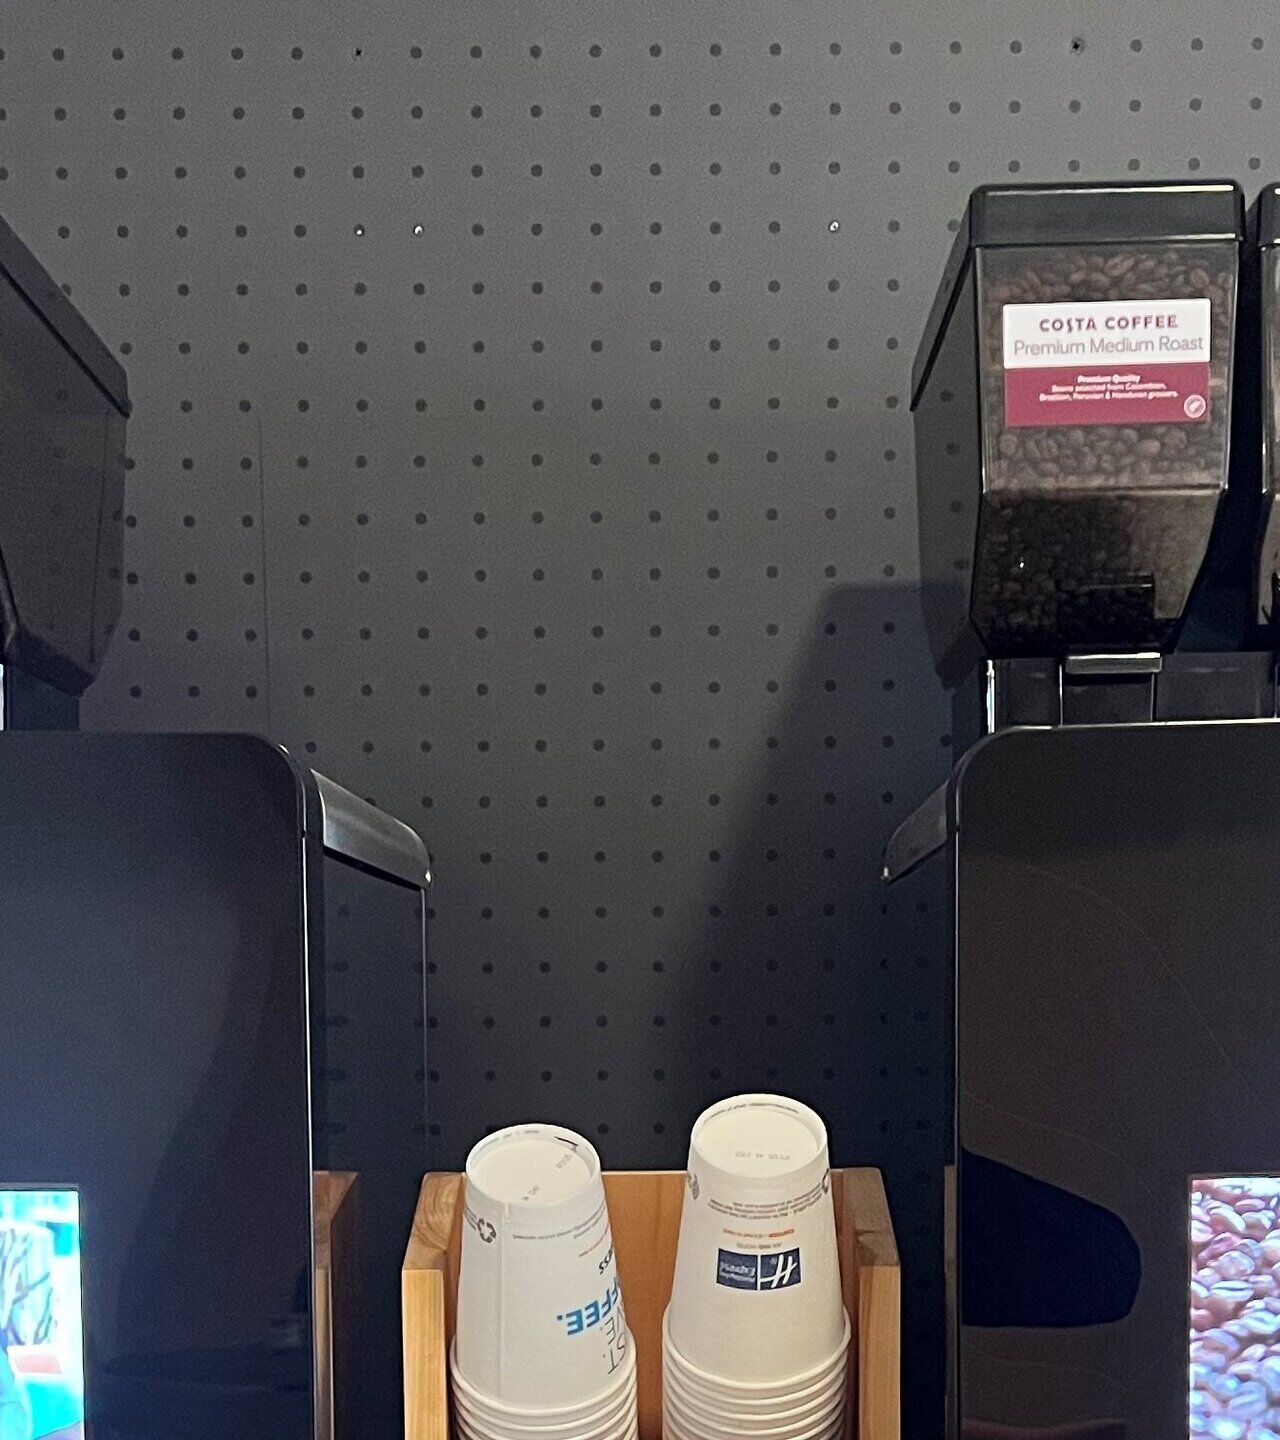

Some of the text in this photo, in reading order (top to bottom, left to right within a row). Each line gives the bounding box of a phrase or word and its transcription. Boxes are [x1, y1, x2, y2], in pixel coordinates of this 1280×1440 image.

[1039, 315, 1179, 334] COSTA COFFEE
[1014, 335, 1204, 356] Premium Medium Roast
